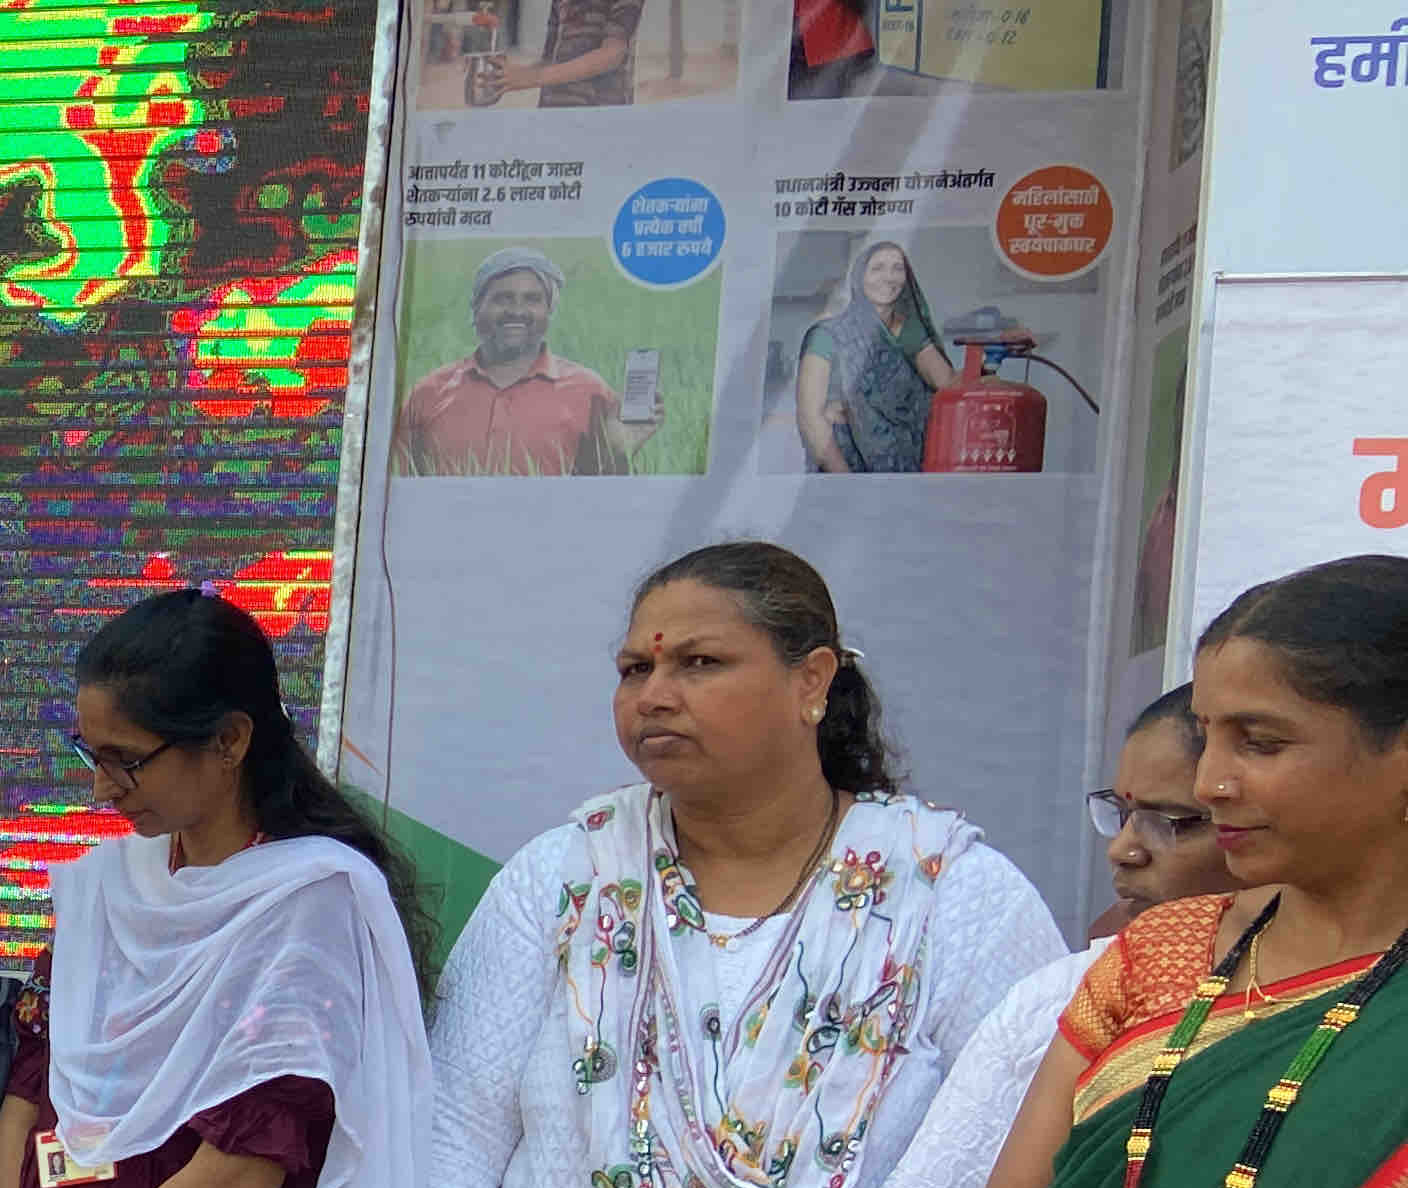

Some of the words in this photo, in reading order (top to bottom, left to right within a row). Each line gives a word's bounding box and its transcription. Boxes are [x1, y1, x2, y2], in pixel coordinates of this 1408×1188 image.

[482, 187, 506, 202] 2.6
[510, 186, 546, 201] लाख
[548, 181, 582, 201] कोटी
[775, 172, 846, 194] प्रधानमंत्री
[775, 200, 790, 216] 10
[795, 196, 828, 216] कोटी
[832, 195, 856, 216] गॅस
[859, 196, 915, 216] जोडण्या
[459, 210, 493, 226] मदत
